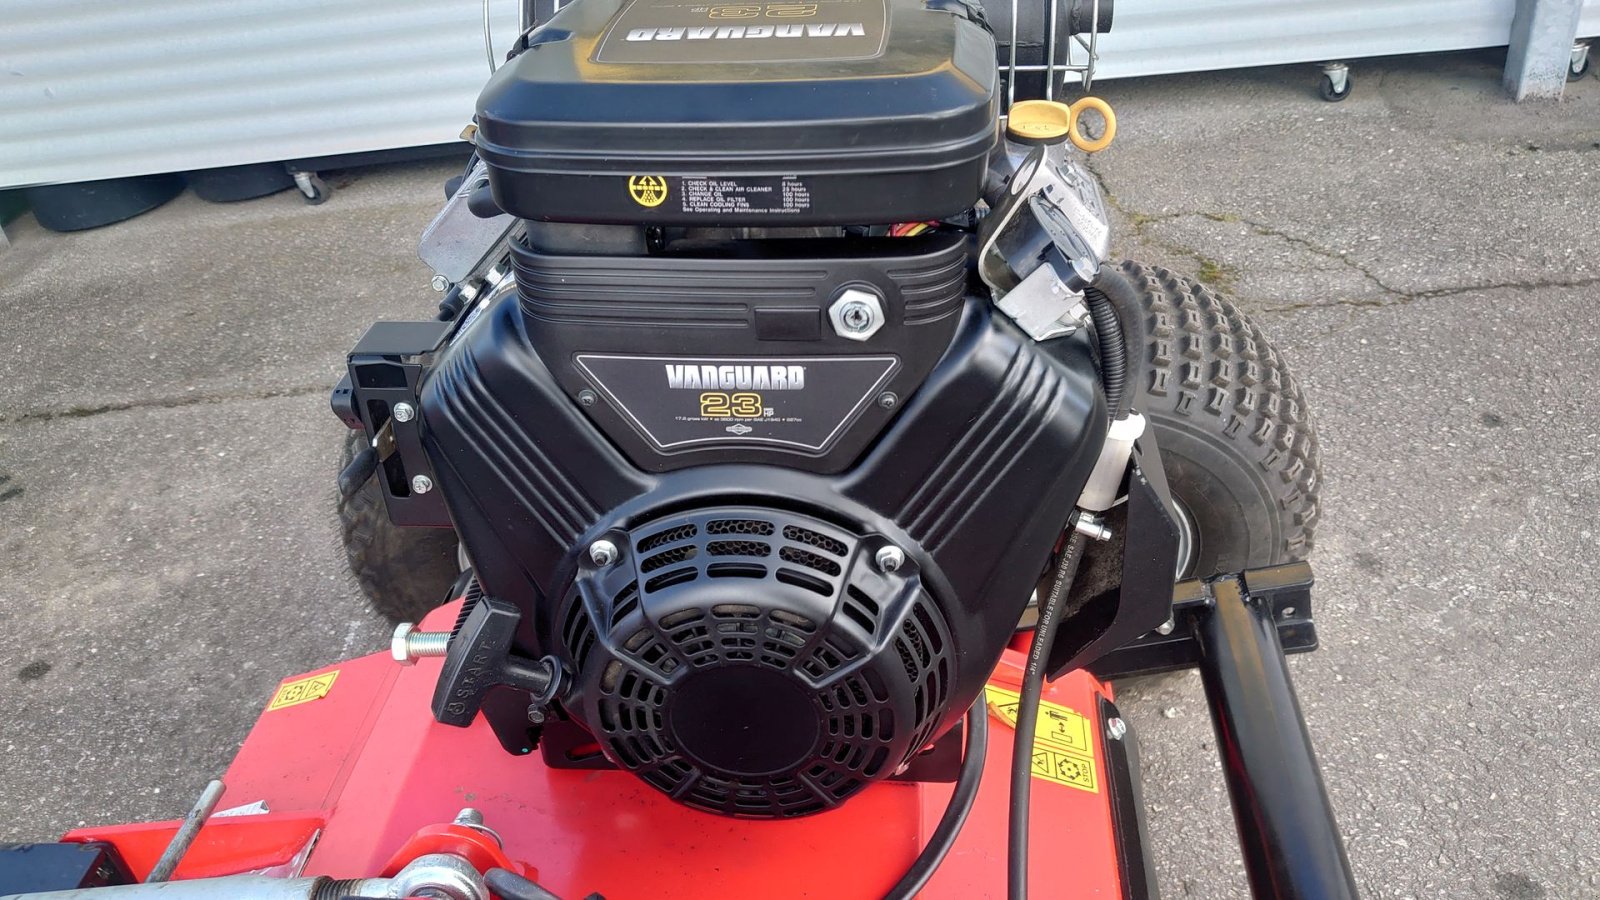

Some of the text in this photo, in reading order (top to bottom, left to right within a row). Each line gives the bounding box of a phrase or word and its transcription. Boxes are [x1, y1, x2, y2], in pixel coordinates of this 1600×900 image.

[707, 4, 818, 19] 23
[626, 23, 865, 41] VANGUARD
[665, 364, 805, 390] VANGUARD
[700, 392, 762, 417] 23
[1065, 545, 1074, 559] SAE
[1046, 580, 1062, 611] SUITABLE
[1042, 611, 1052, 625] FOR
[1033, 624, 1048, 660] UNLEADED
[456, 641, 495, 699] START
[1081, 763, 1090, 783] STOP
